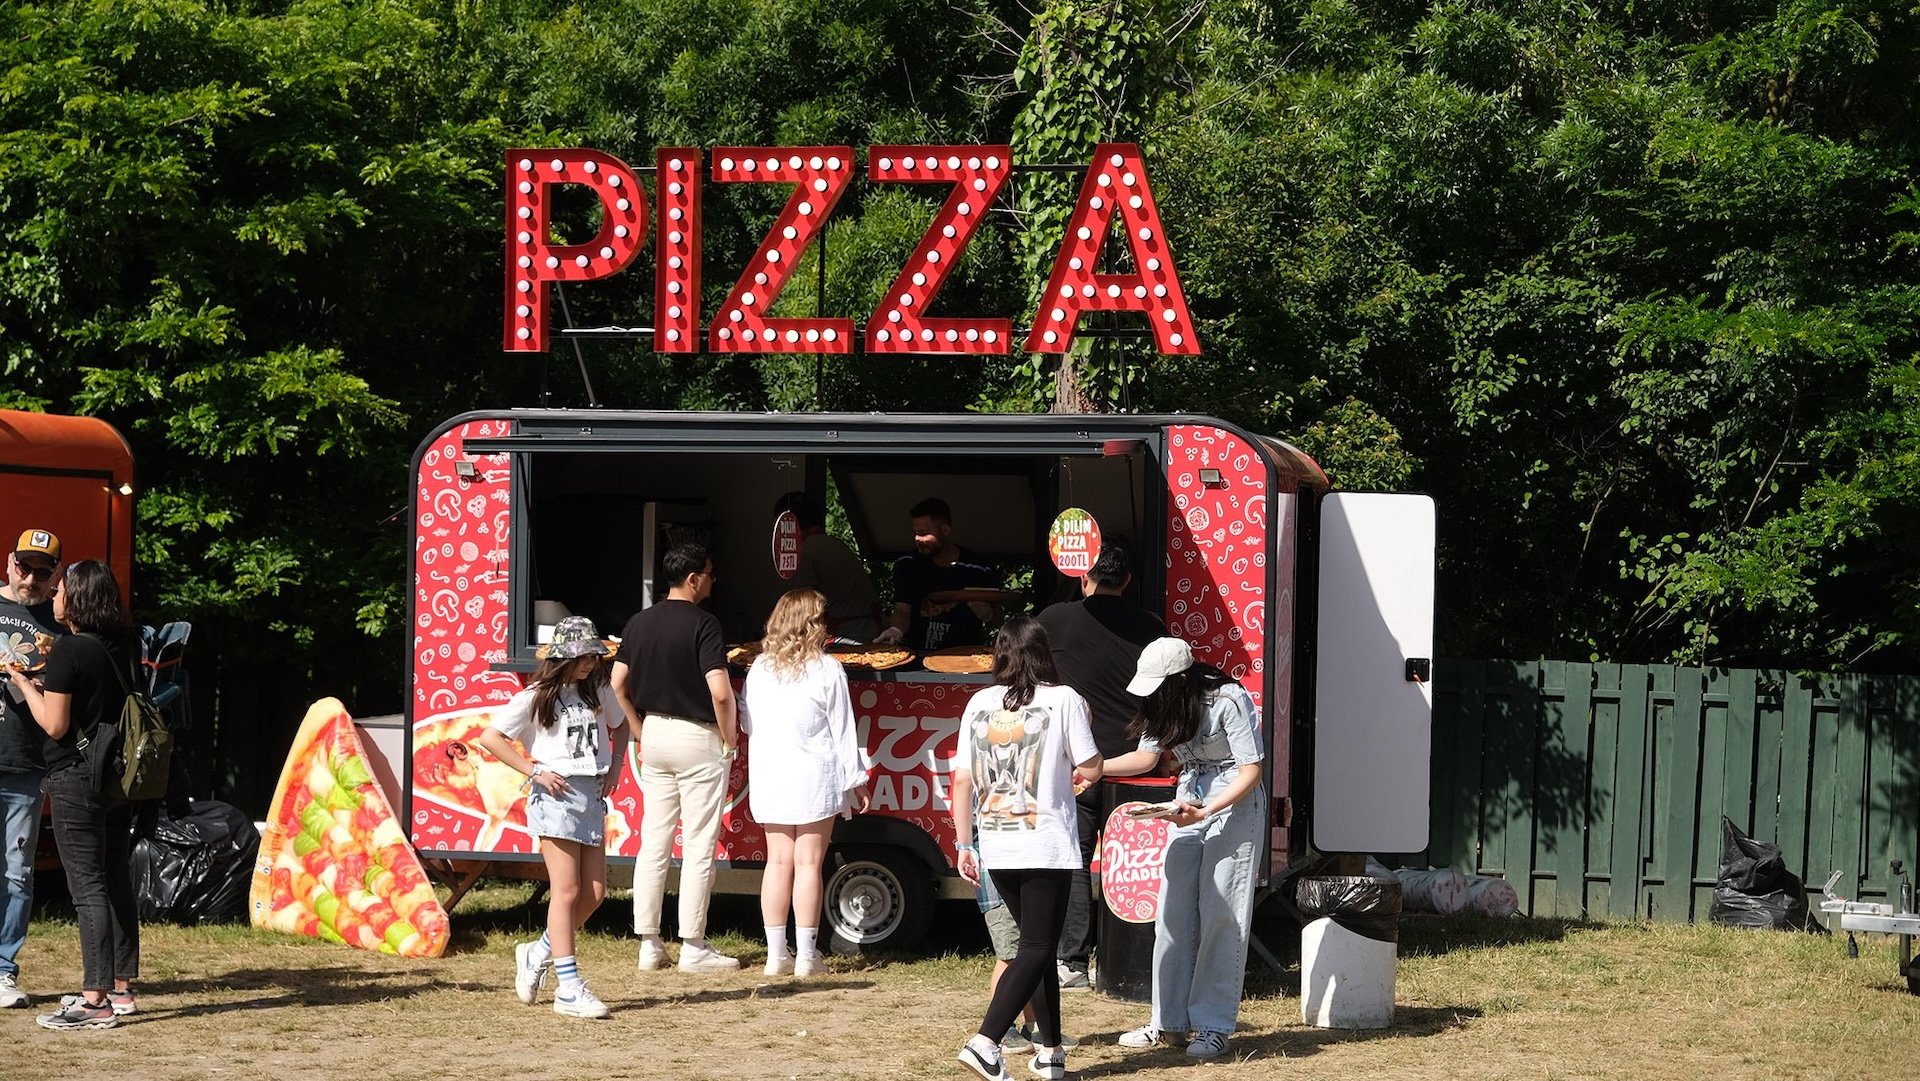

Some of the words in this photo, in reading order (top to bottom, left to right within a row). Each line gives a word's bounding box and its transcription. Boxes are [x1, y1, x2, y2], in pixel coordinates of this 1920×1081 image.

[503, 142, 1203, 355] PIZZA
[1059, 554, 1087, 567] 200TL
[21, 620, 37, 635] OTH
[926, 630, 945, 642] EAT
[928, 621, 951, 633] JUST
[567, 723, 599, 759] 70
[856, 690, 961, 774] izz
[1104, 840, 1165, 885] Pizz
